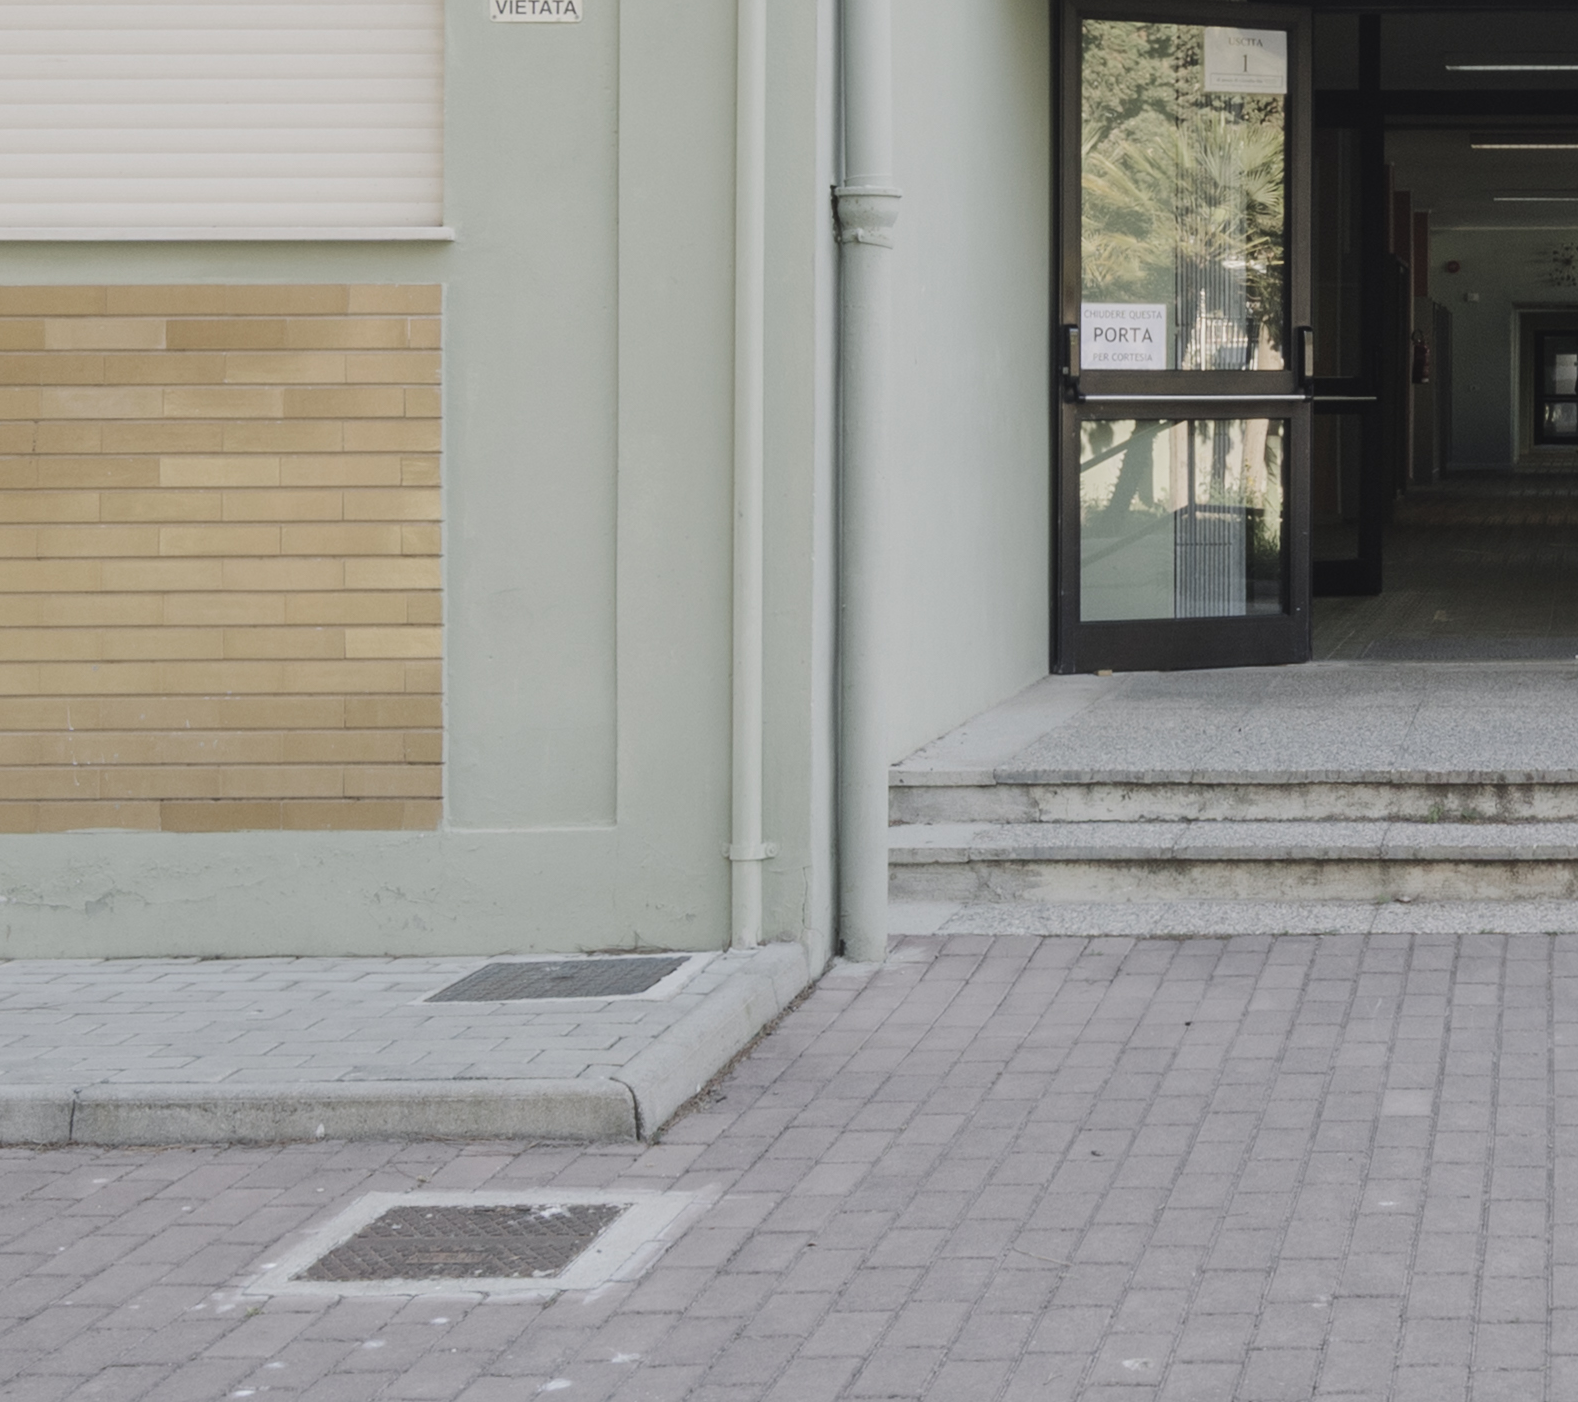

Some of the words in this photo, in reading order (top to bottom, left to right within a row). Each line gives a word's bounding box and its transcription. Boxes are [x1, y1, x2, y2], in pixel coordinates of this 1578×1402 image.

[495, 0, 578, 15] VIETATA
[1228, 37, 1264, 47] USCITA
[1243, 54, 1248, 73] 1
[1083, 309, 1126, 319] CHIUDERE
[1128, 310, 1162, 320] QUESTA
[1093, 327, 1153, 343] PORTA
[1092, 353, 1110, 362] PER
[1111, 353, 1153, 362] CORTESIA
